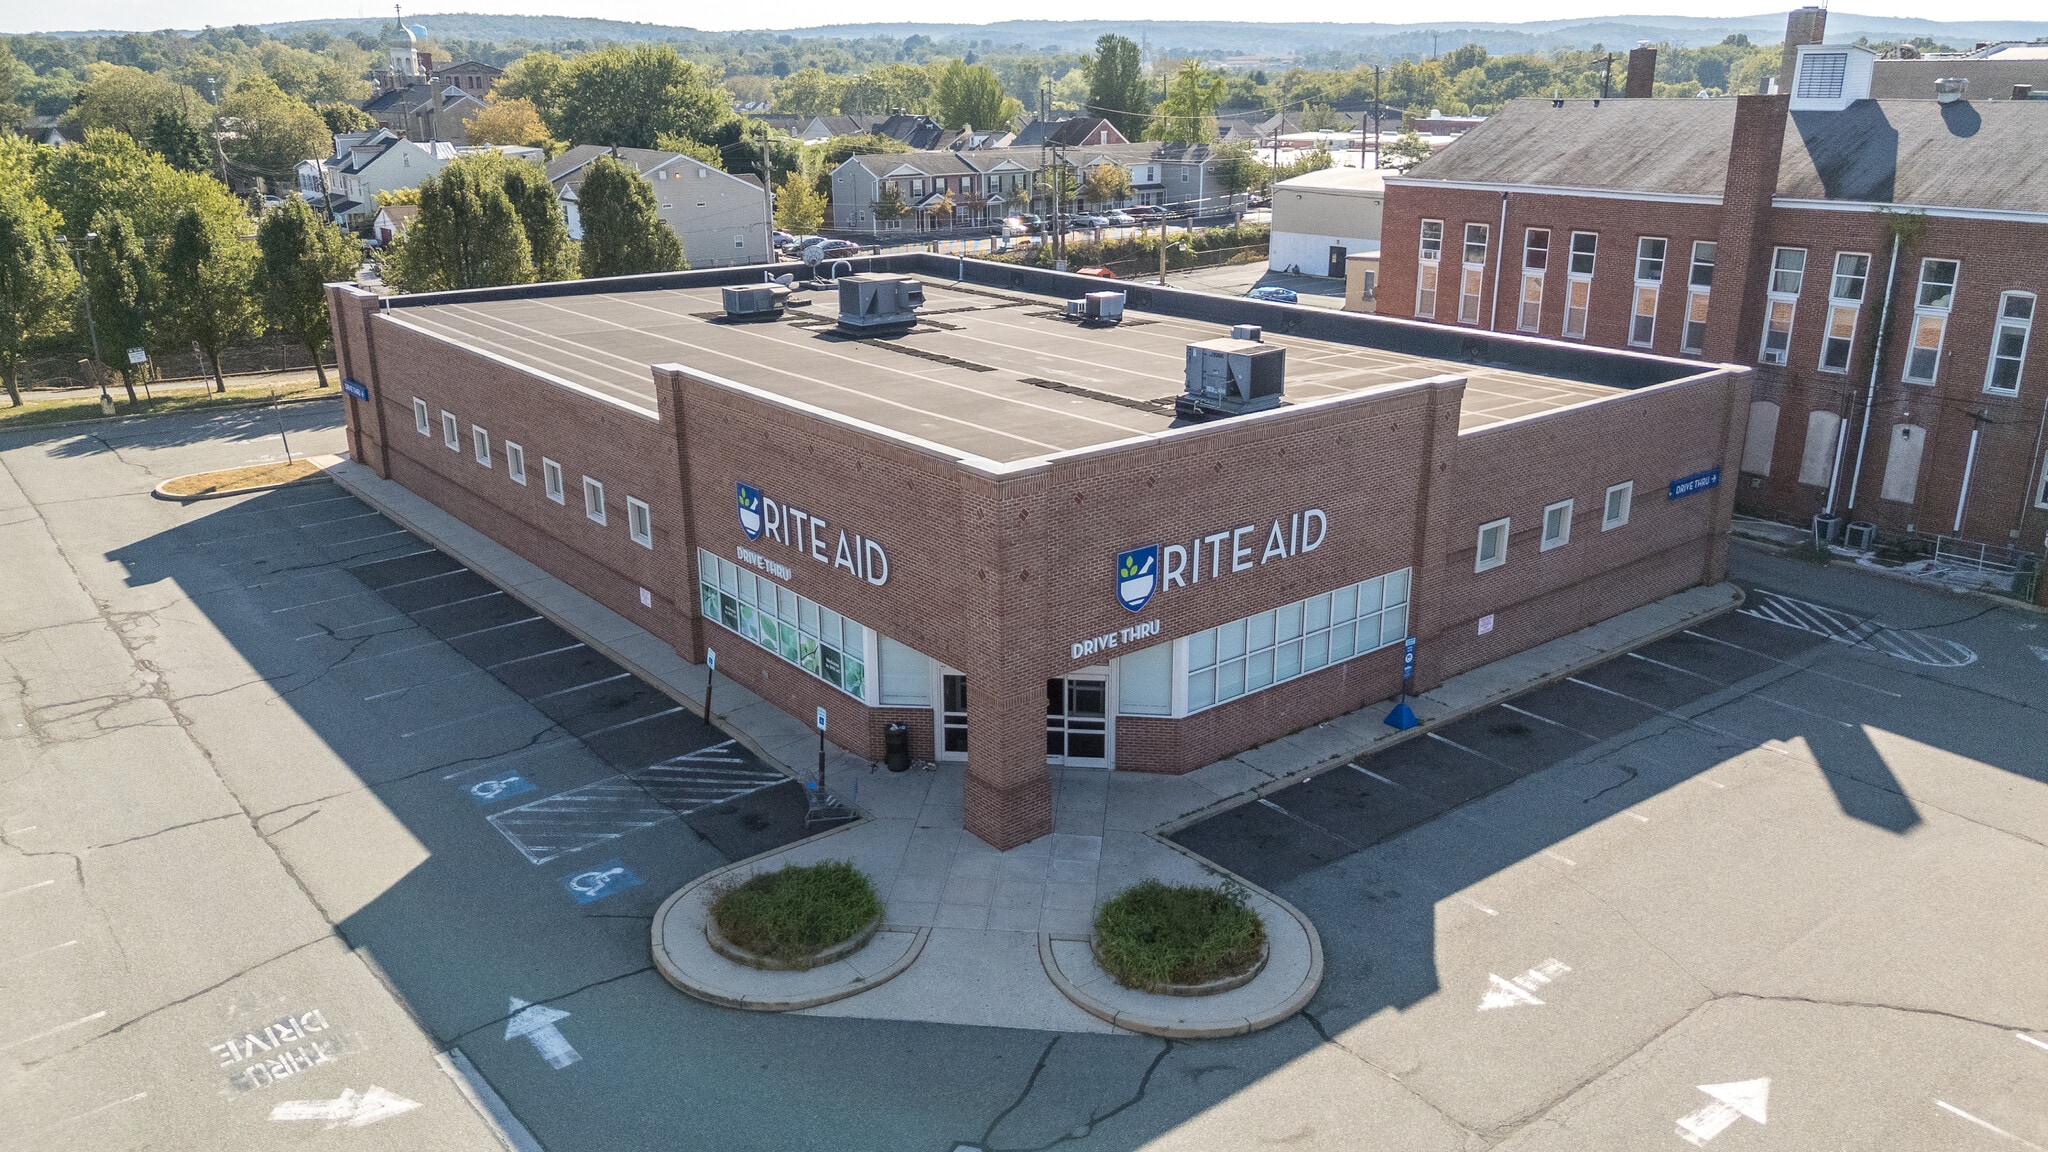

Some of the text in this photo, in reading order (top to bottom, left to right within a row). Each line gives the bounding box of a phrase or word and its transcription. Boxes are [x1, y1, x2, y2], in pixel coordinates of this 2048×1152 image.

[1675, 476, 1710, 495] DRIVE THRU
[736, 546, 792, 581] DRIVE THRU
[762, 496, 889, 587] RITE AID
[1162, 508, 1328, 592] RITE AID
[1070, 619, 1160, 660] DRIVE THRU
[210, 1009, 330, 1068] DRIVE
[242, 1041, 331, 1088] THRU
